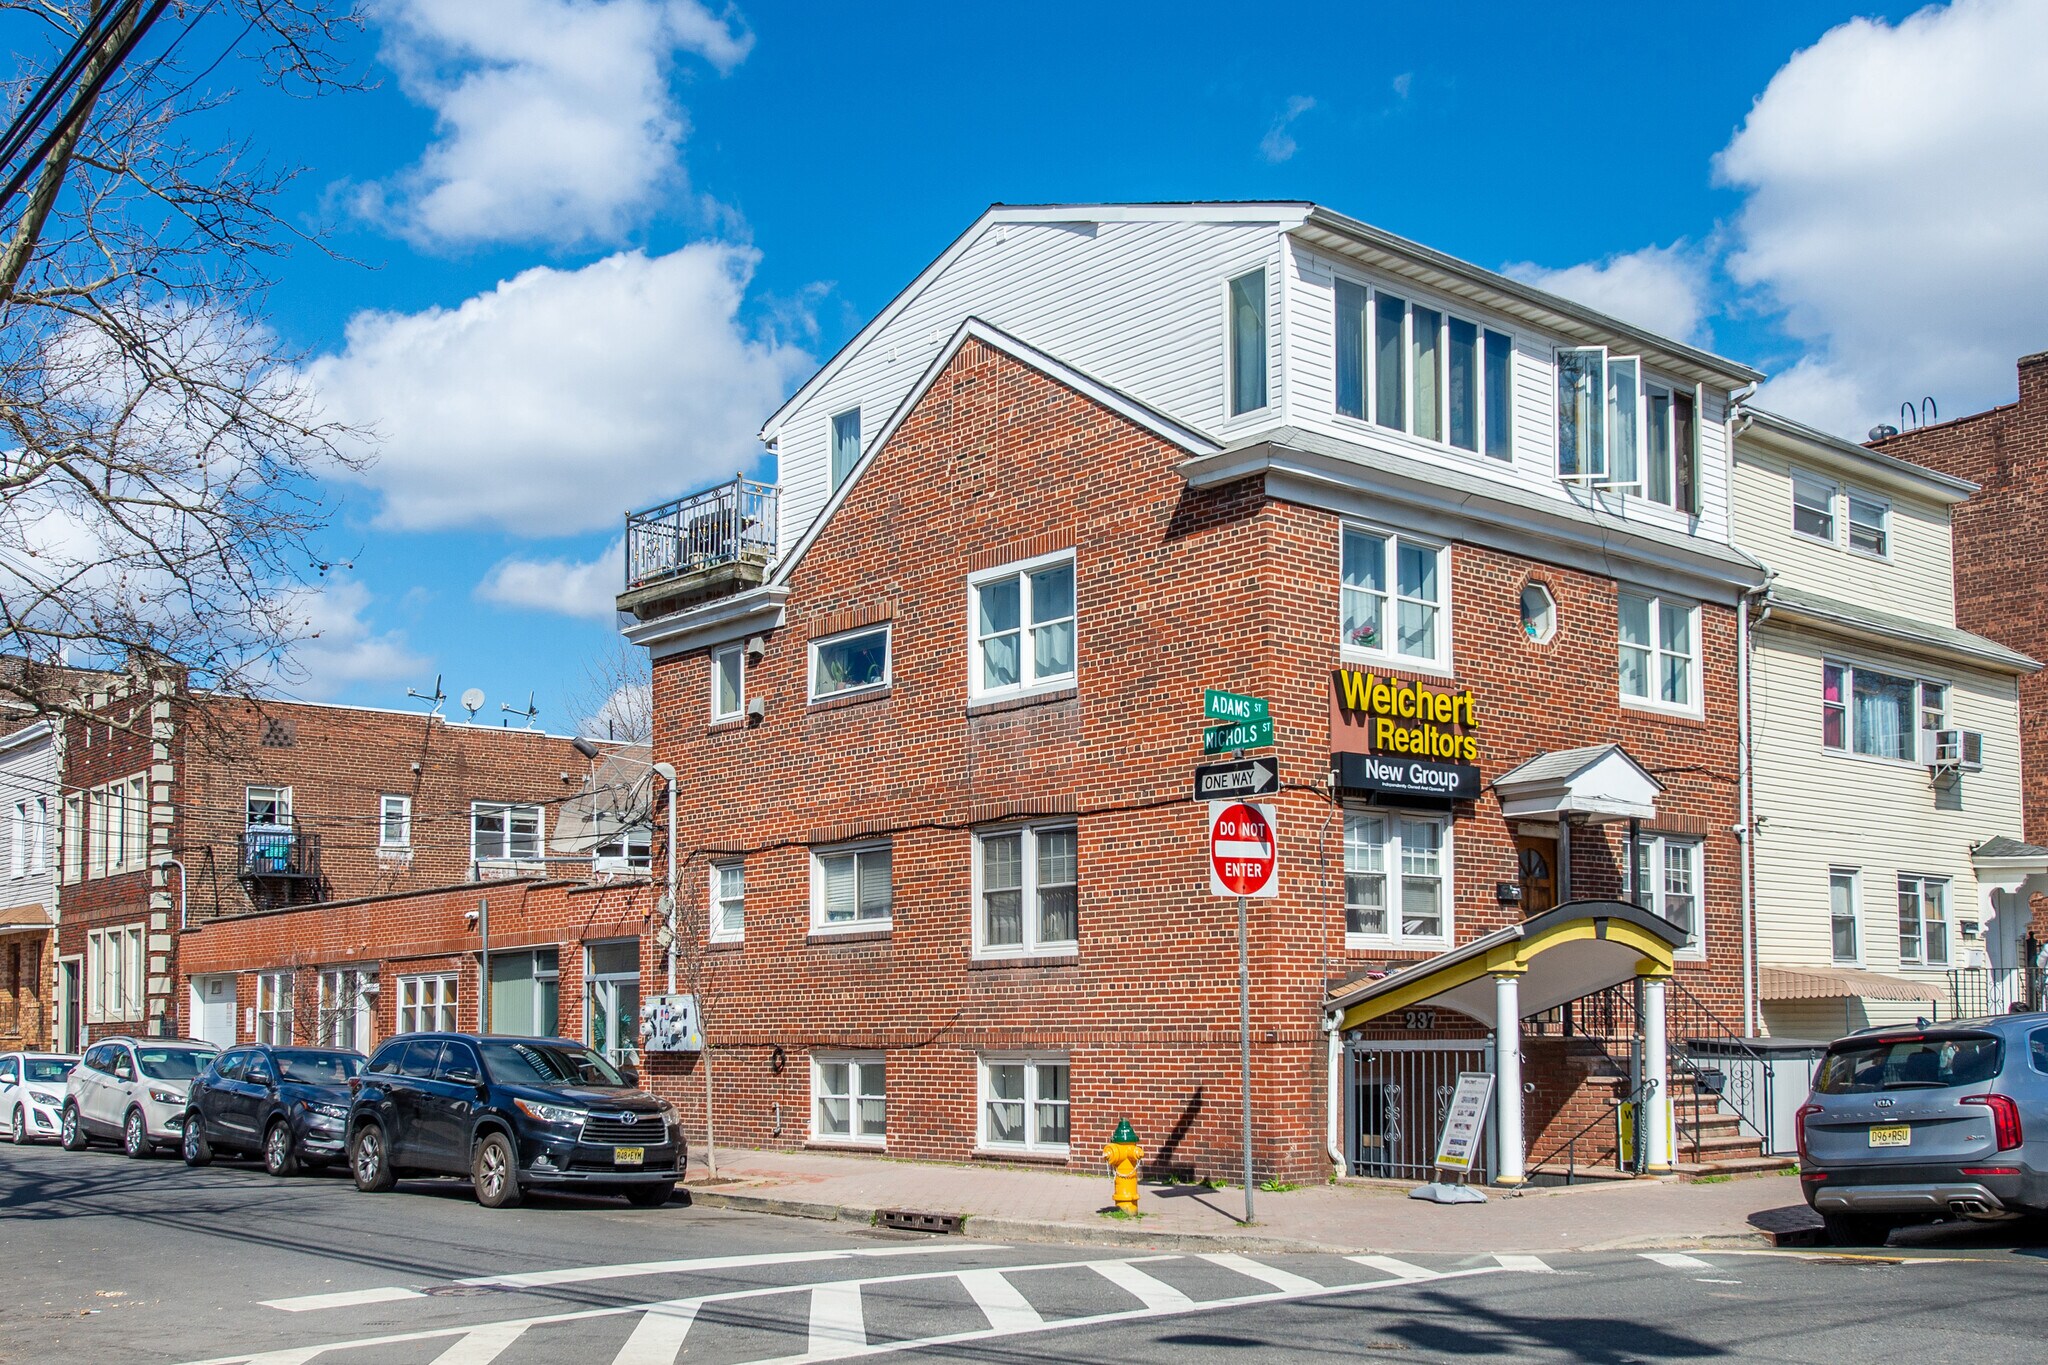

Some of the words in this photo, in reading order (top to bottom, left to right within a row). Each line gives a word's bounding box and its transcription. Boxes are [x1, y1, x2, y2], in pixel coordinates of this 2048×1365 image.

[1211, 695, 1250, 718] ADAMS
[1254, 703, 1262, 713] ST
[1206, 724, 1257, 748] NICHOLS
[1262, 721, 1271, 733] ST
[1376, 717, 1477, 760] Realtors
[1205, 775, 1228, 790] ONE
[1231, 771, 1255, 786] WAY
[1365, 758, 1403, 782] New
[1409, 763, 1459, 792] Group
[1219, 821, 1235, 837] DO
[1242, 822, 1265, 838] NOT
[1225, 863, 1262, 878] ENTER
[1406, 1011, 1436, 1029] 237
